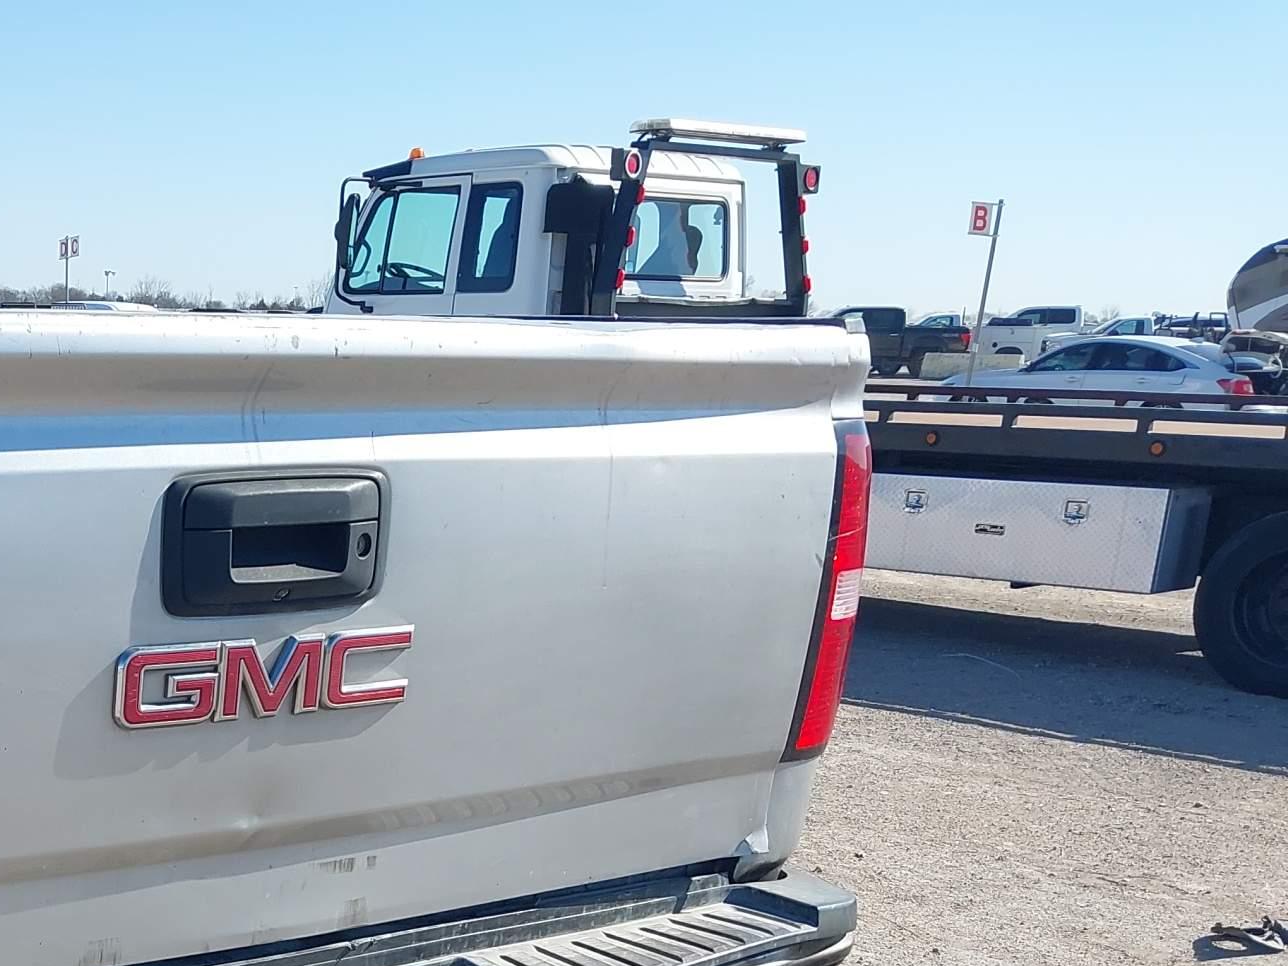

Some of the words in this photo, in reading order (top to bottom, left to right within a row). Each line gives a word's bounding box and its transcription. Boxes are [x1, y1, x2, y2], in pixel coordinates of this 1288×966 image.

[973, 205, 988, 231] B
[71, 238, 78, 254] C
[112, 623, 416, 730] GMC
